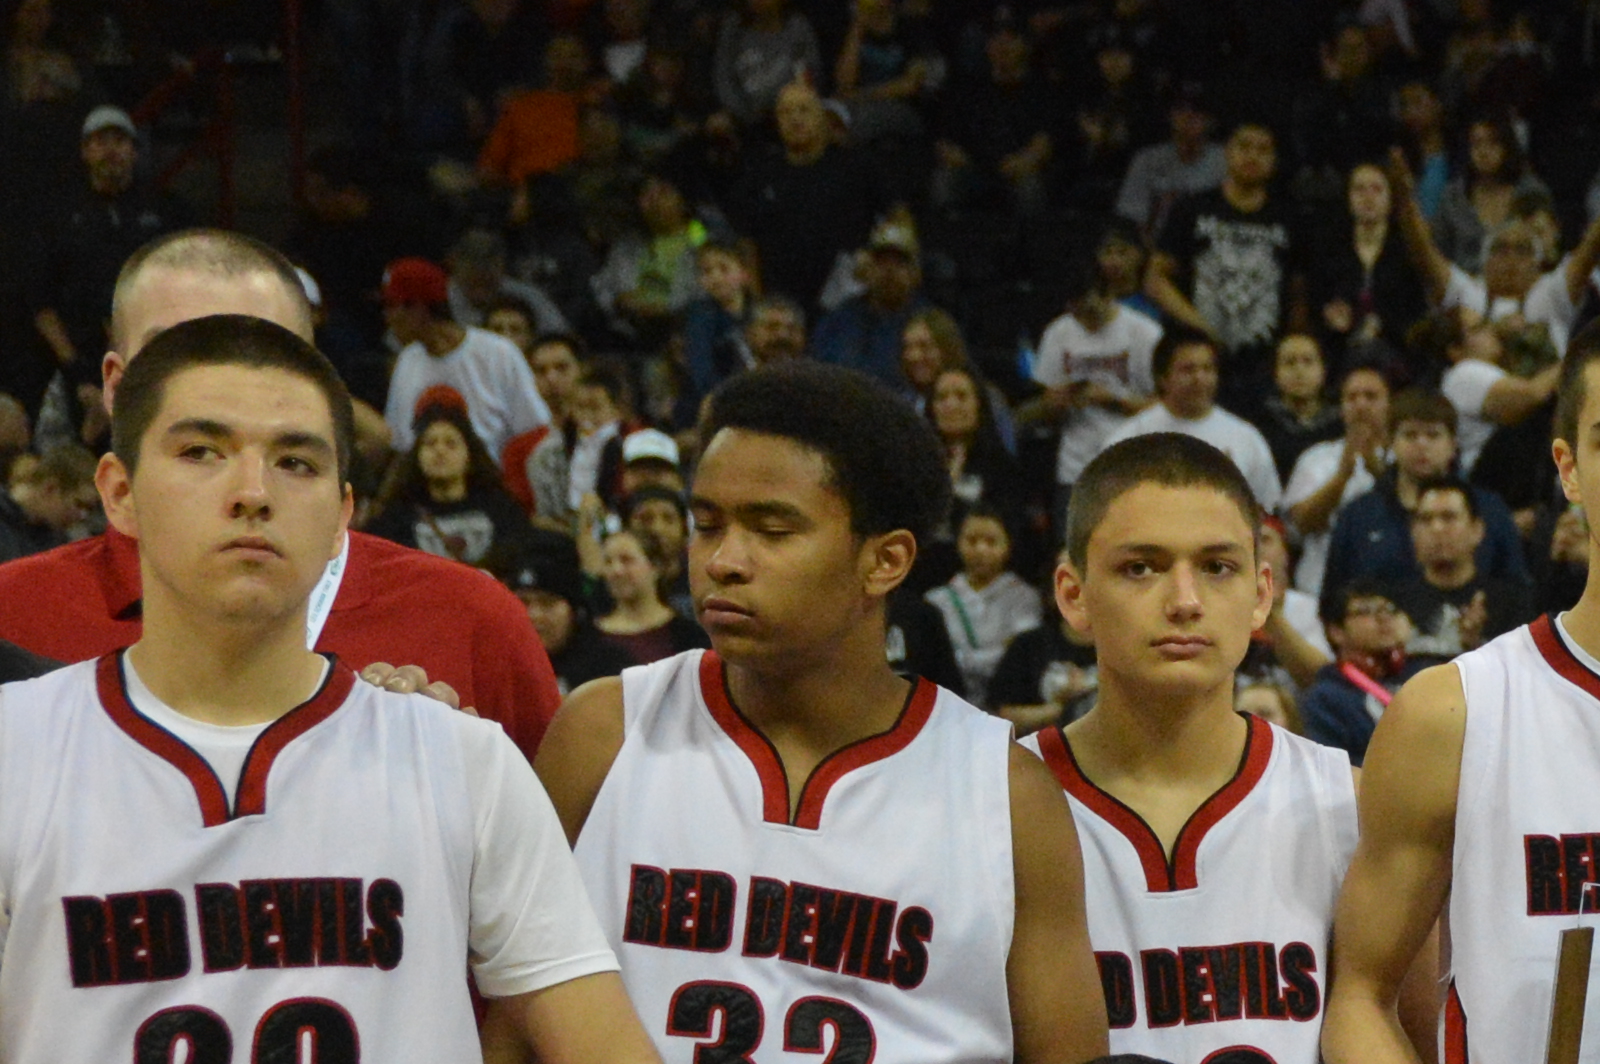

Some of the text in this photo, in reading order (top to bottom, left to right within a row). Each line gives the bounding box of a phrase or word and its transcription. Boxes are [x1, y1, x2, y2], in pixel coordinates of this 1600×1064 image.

[61, 877, 404, 988] RED DEVILS
[622, 864, 934, 990] RED DEVILS
[1140, 941, 1321, 1029] DEVILS
